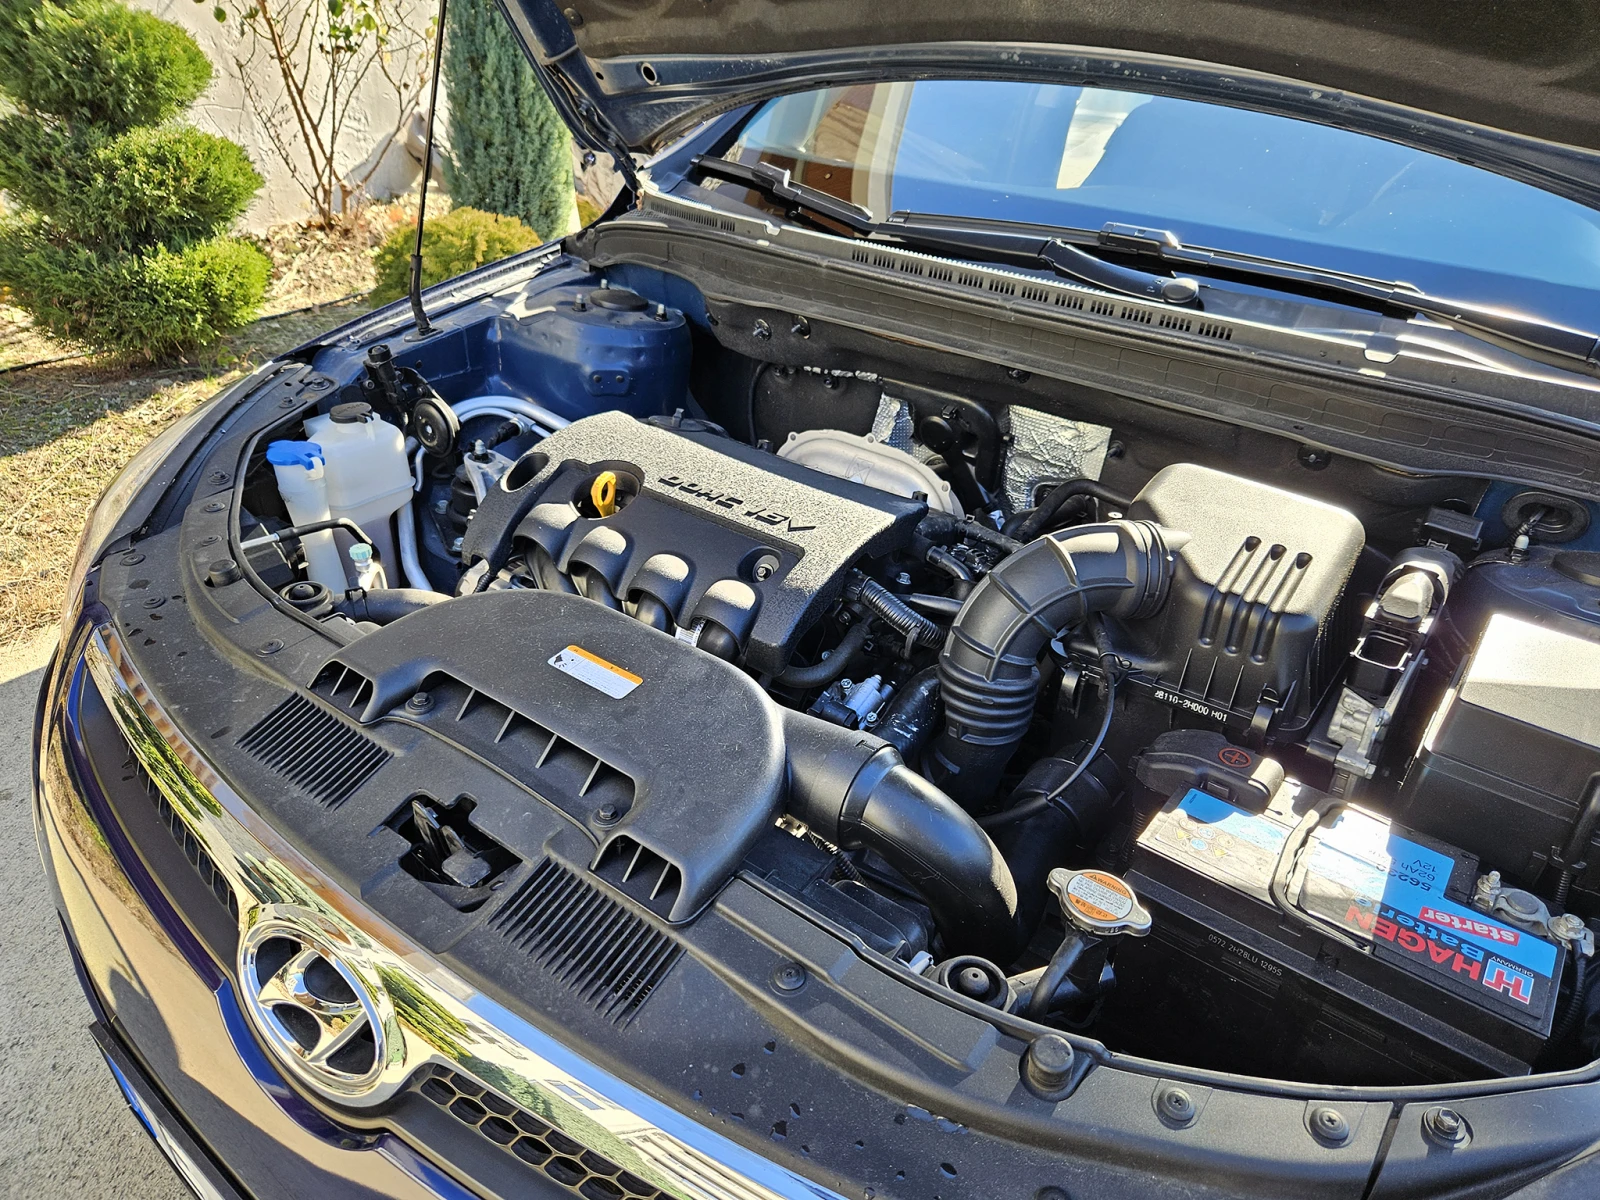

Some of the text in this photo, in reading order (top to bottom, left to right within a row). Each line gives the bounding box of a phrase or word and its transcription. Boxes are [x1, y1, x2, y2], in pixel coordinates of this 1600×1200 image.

[1401, 863, 1435, 881] 62Ah
[1413, 860, 1436, 872] 12V
[1097, 878, 1127, 895] WARNING
[1355, 895, 1485, 962] Batterie
[1423, 907, 1515, 942] starter
[1208, 934, 1226, 948] 0572
[1345, 906, 1482, 981] HAGEN
[1490, 956, 1534, 977] GERMANY
